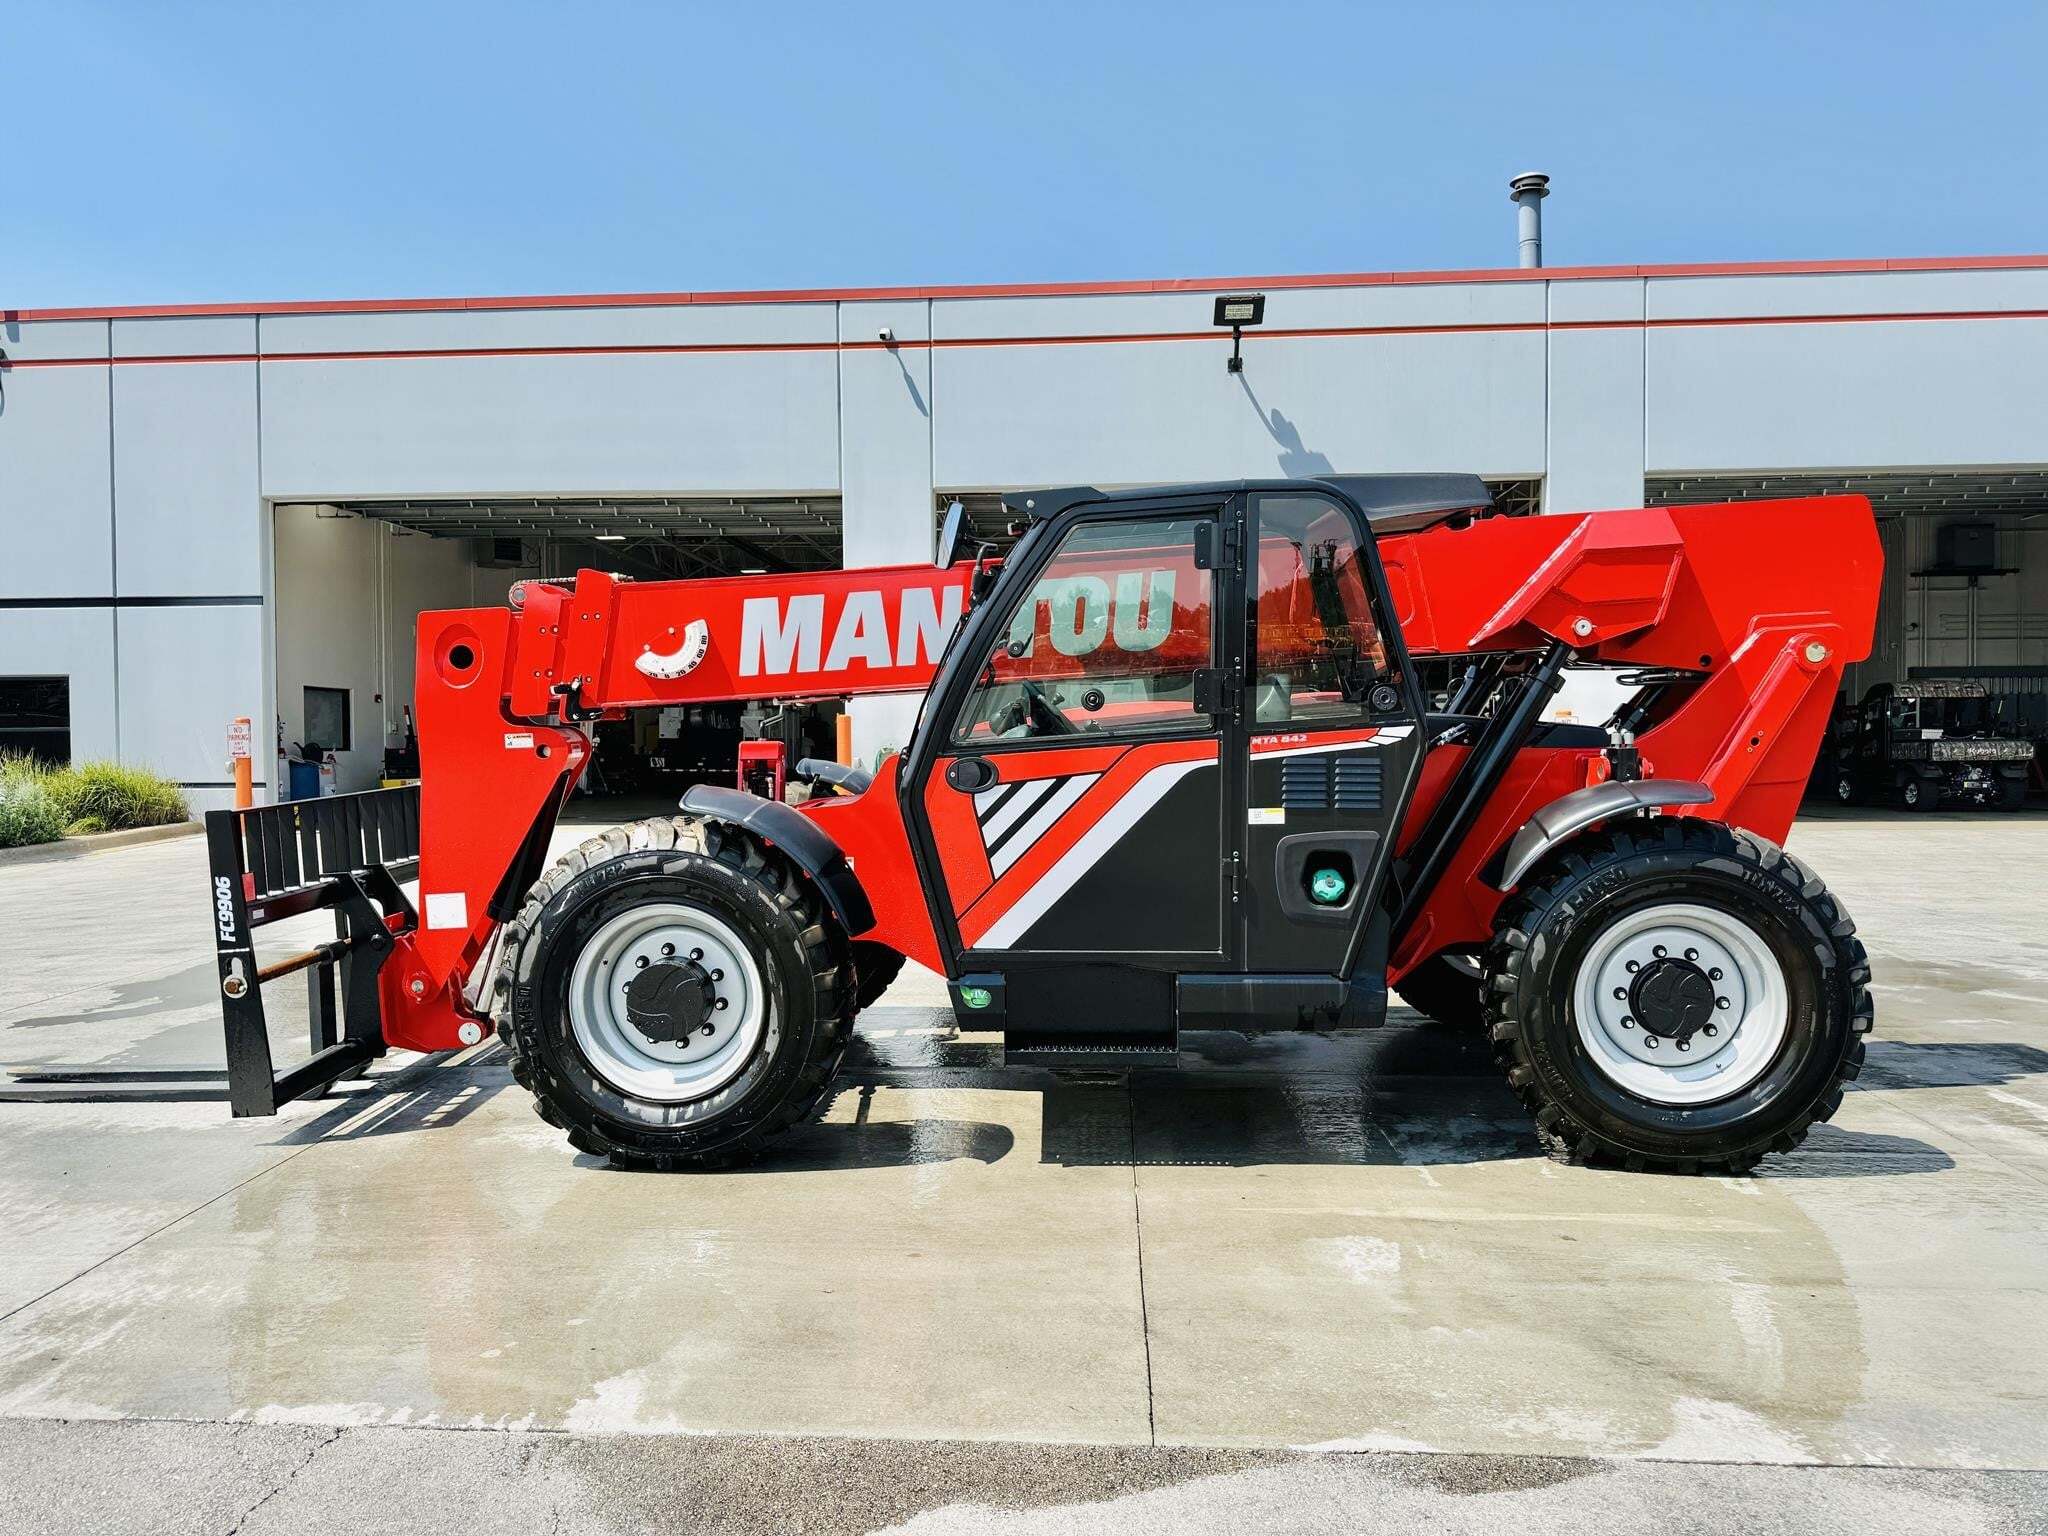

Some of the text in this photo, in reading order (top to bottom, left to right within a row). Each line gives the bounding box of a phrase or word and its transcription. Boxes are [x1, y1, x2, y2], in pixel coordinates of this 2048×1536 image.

[739, 568, 1176, 677] MANTOU
[697, 649, 704, 658] 60
[701, 635, 707, 645] 80
[233, 726, 243, 734] NO
[1250, 734, 1308, 744] MTA 842
[1969, 747, 1997, 755] Kubota
[215, 876, 236, 942] FC9906
